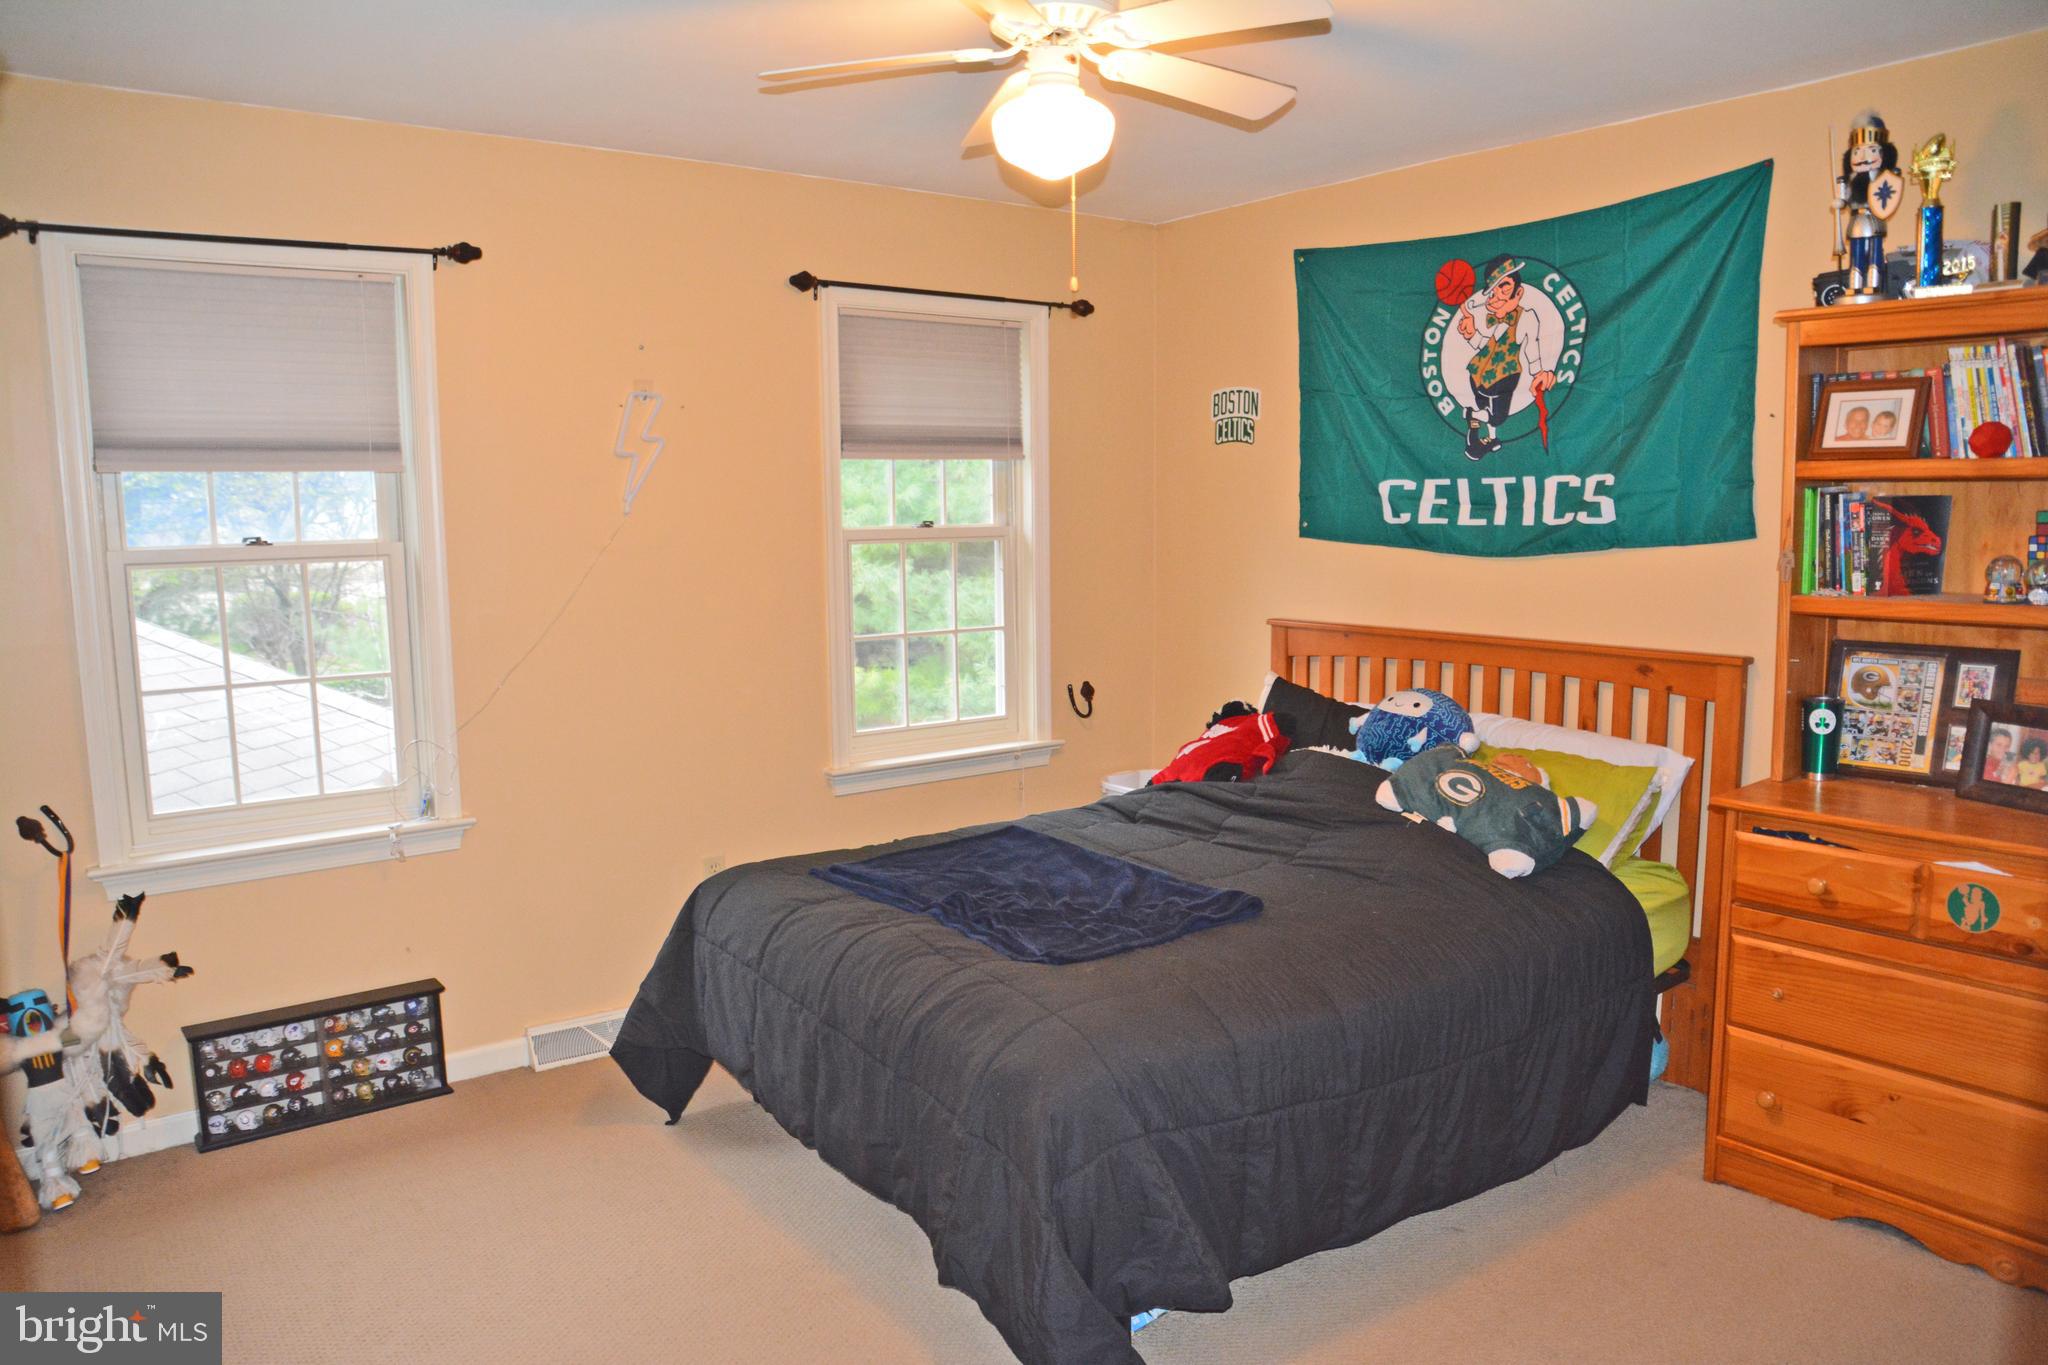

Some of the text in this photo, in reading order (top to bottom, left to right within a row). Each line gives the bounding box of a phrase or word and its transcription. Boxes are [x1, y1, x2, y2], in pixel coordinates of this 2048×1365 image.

[1942, 256, 1976, 276] 2015
[1422, 272, 1587, 417] BOSTON CELTICS
[1213, 389, 1259, 418] BOSTON
[1216, 418, 1254, 444] CELTICS
[1378, 473, 1617, 526] CELTICS
[1898, 738, 1914, 767] 2010
[1438, 770, 1482, 804] G
